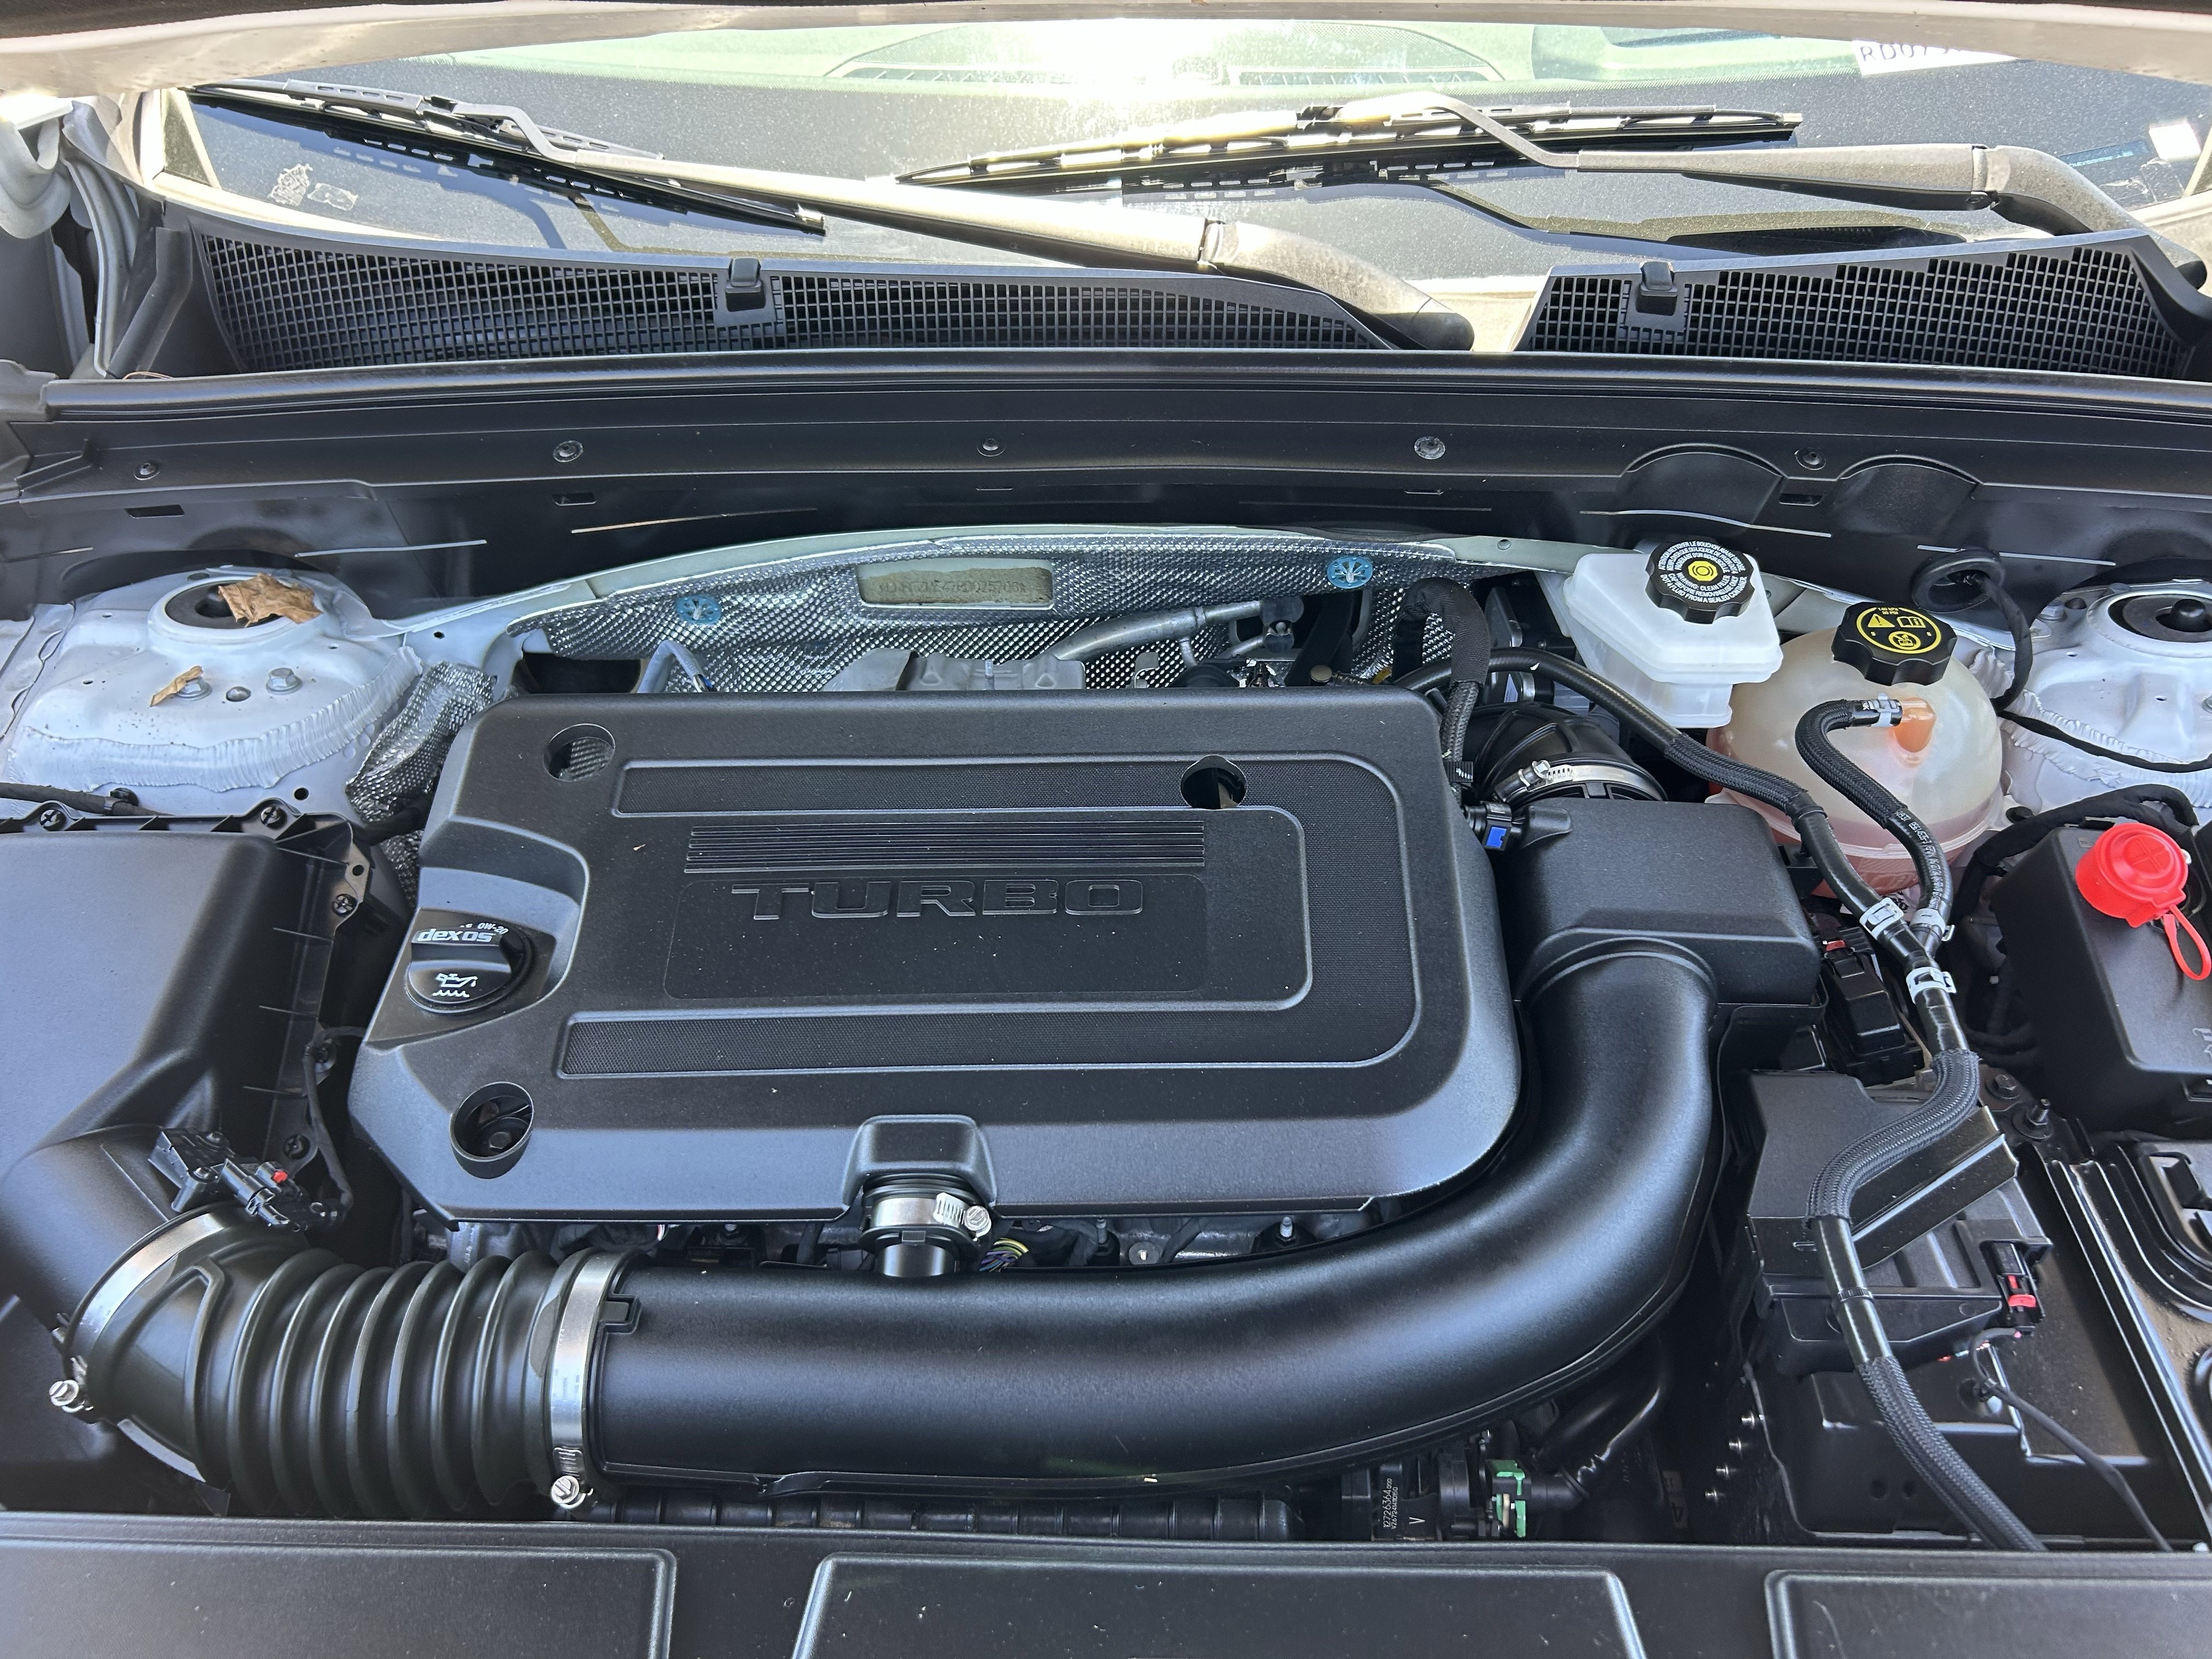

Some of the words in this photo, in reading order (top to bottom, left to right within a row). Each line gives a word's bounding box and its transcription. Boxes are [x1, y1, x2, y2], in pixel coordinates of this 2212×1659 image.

[1718, 547, 1735, 558] AVANT
[1660, 574, 1672, 584] DOT
[1668, 584, 1686, 596] FLUID
[1684, 592, 1702, 602] FROM
[1707, 594, 1731, 603] SEALED
[1667, 573, 1679, 583] CAP
[1674, 580, 1696, 595] BEFORE
[1728, 575, 1739, 587] ONLY
[1675, 572, 1699, 590] WARNING:
[1716, 574, 1730, 588] FILLER
[731, 879, 1143, 921] TURBO
[417, 928, 494, 943] dexos
[477, 922, 509, 934] 0W-20
